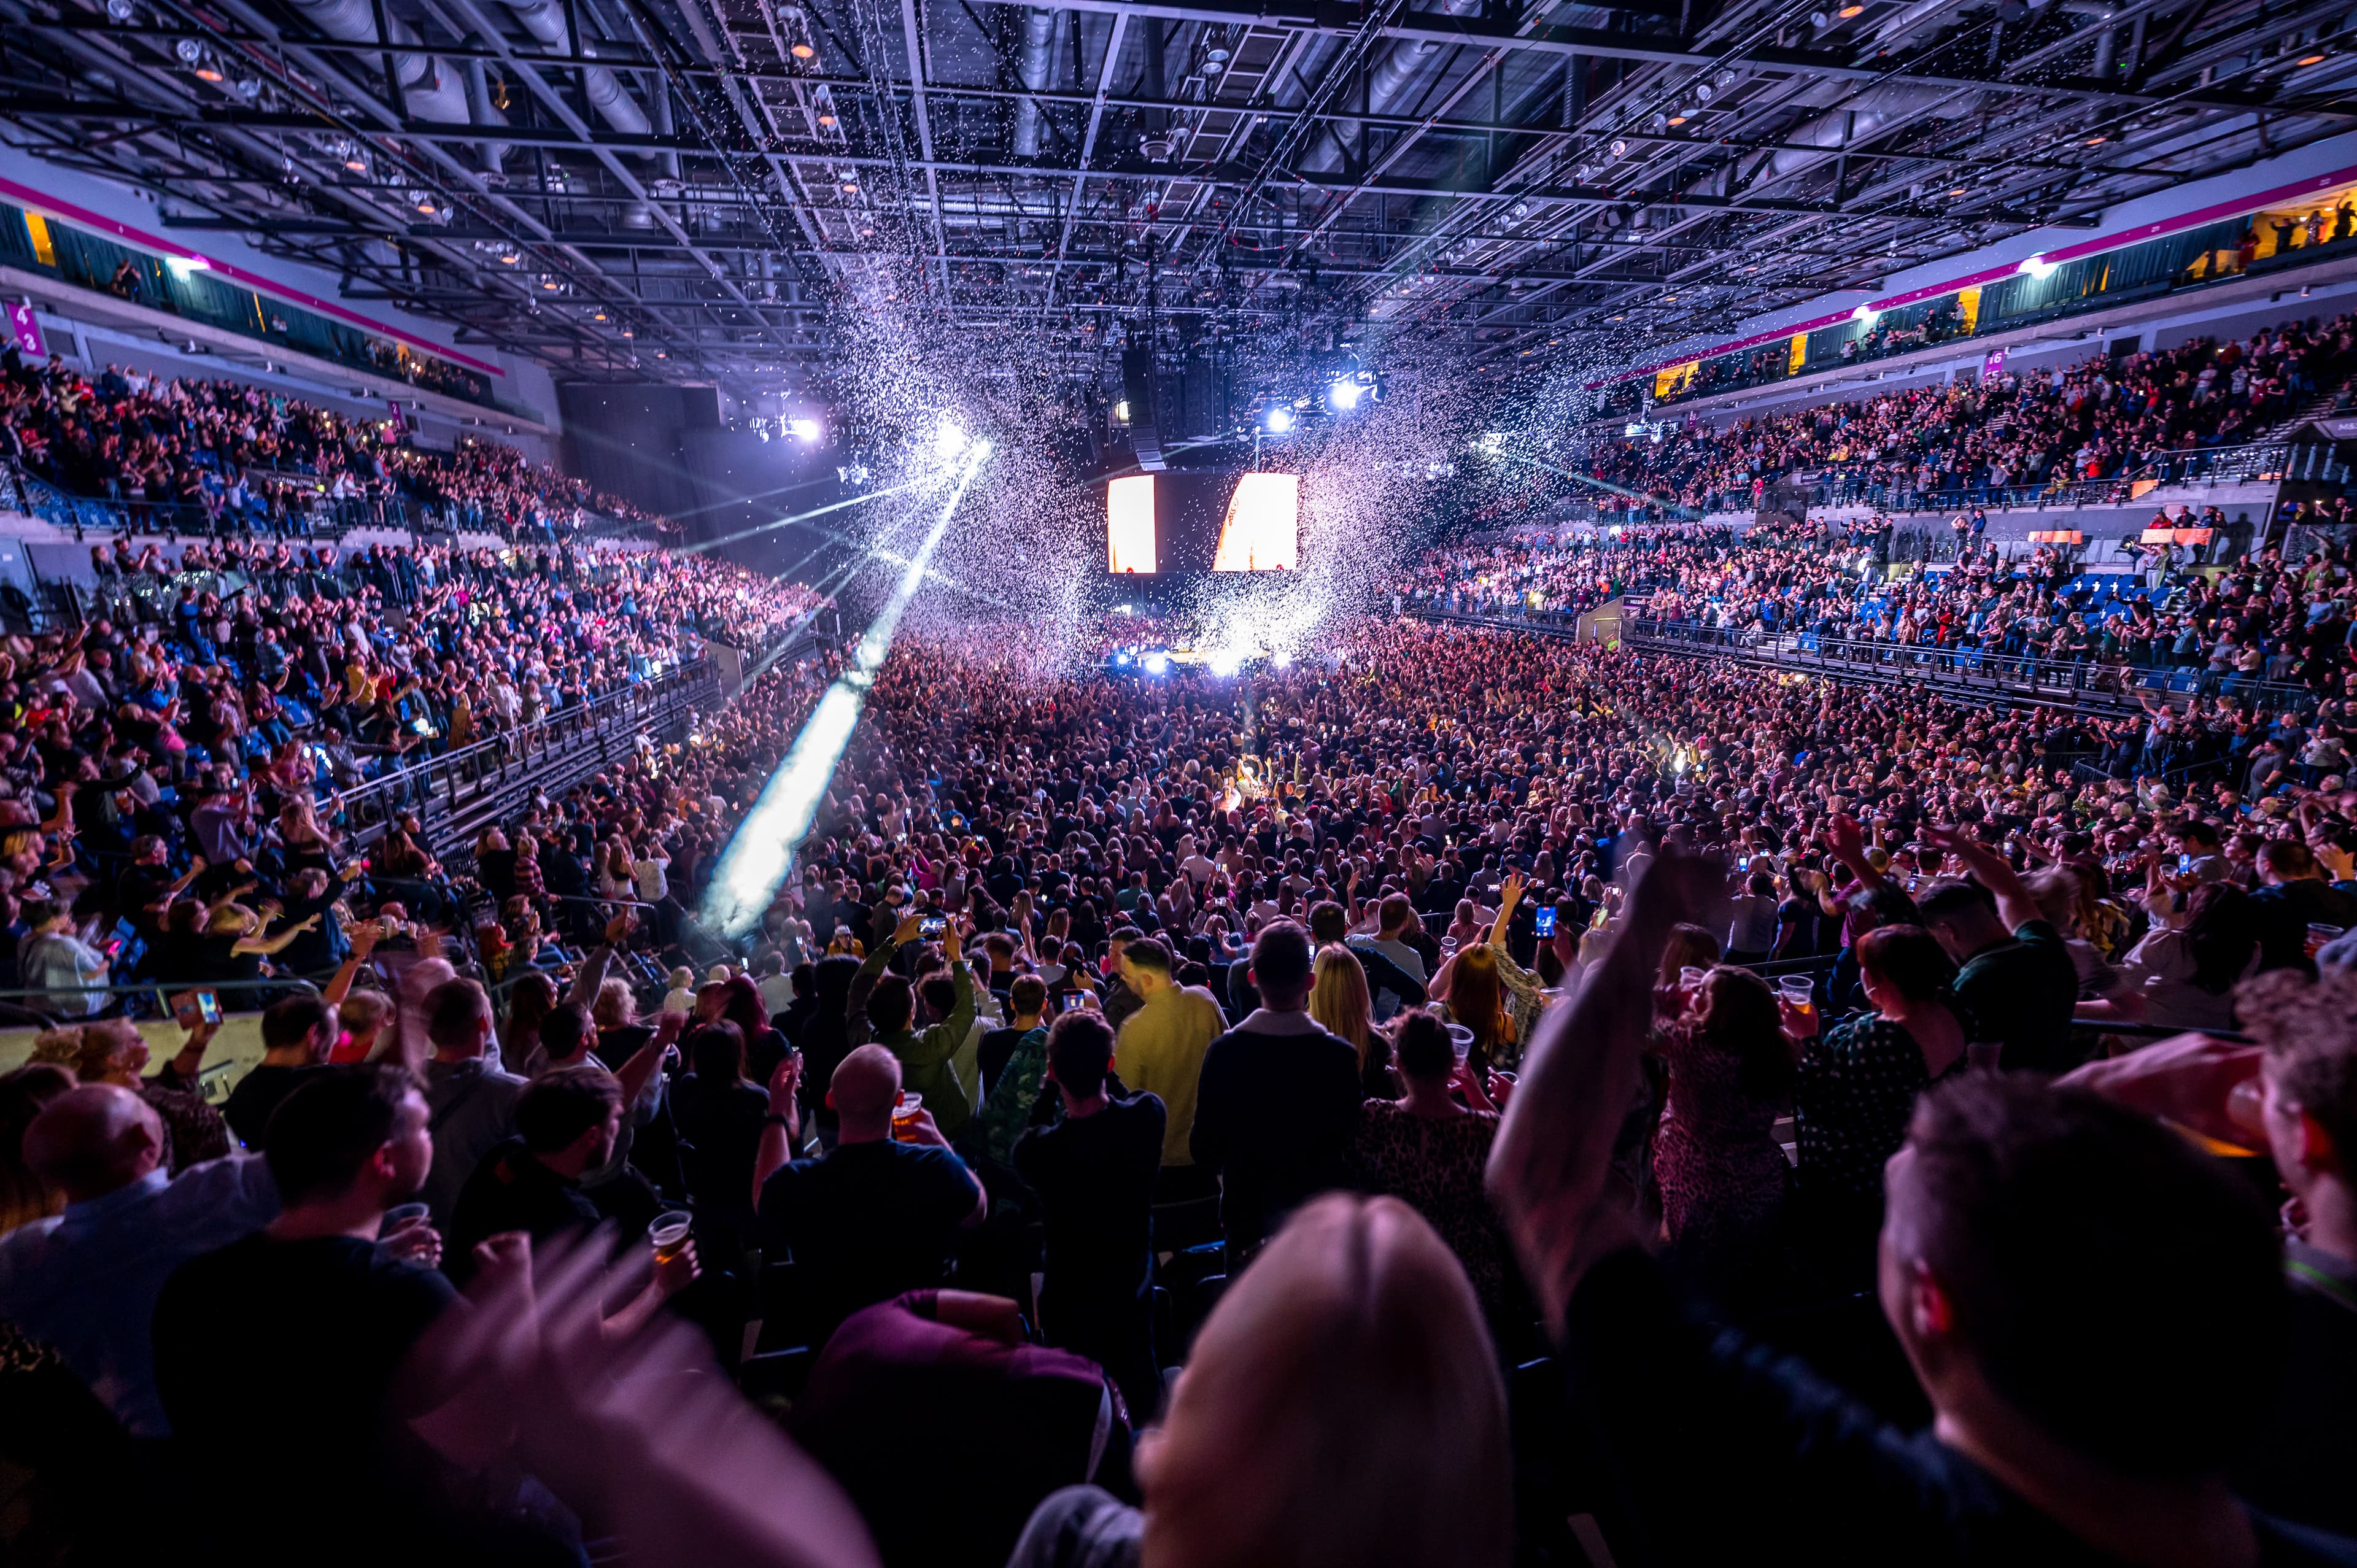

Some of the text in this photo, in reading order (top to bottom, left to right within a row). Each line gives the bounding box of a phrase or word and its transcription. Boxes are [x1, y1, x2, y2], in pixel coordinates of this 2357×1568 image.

[17, 307, 28, 325] 4
[1987, 352, 2002, 365] 16
[392, 403, 398, 415] 2
